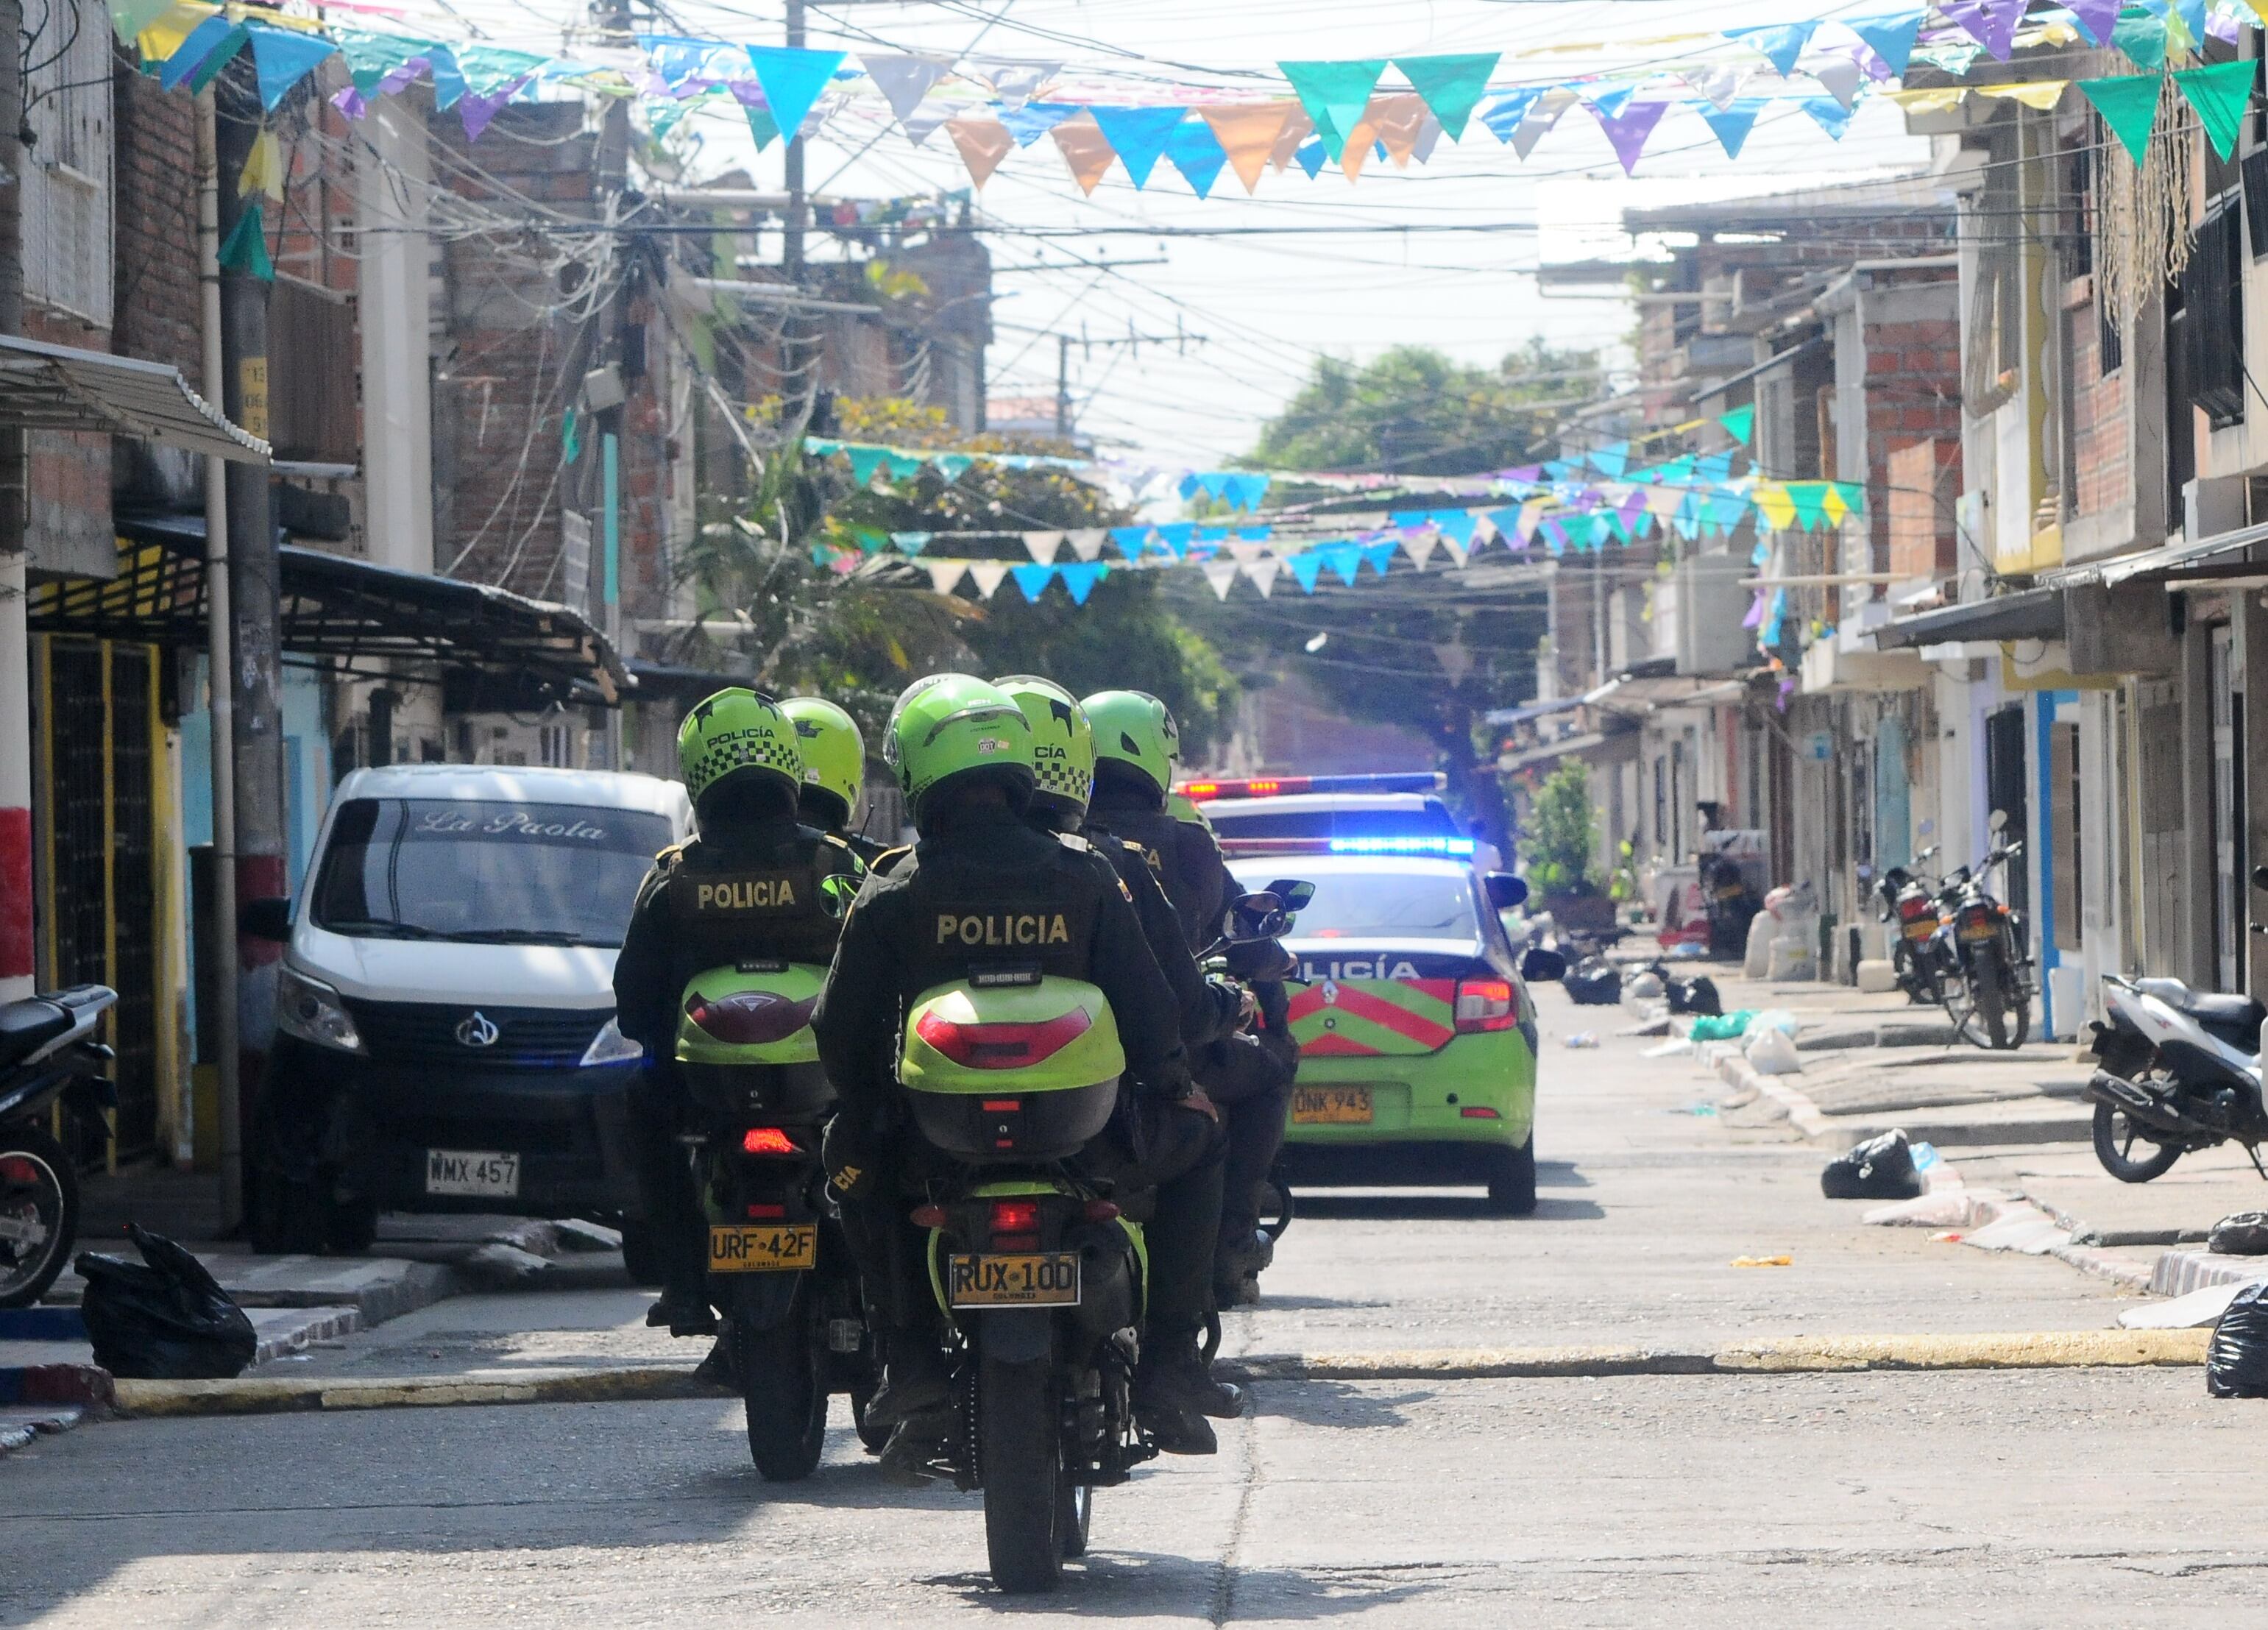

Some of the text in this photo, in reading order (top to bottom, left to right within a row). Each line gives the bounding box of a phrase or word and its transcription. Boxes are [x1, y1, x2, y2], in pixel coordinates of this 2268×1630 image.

[706, 726, 775, 748] POLICÍA
[1034, 743, 1067, 760] CÍA
[415, 812, 607, 840] La Paola
[698, 879, 795, 909] POLICIA
[937, 914, 1069, 945] POLICIA
[1296, 953, 1421, 979] LICÍA
[430, 1157, 515, 1184] WMX 457
[832, 1166, 862, 1191] CIA
[712, 1232, 812, 1259] URF 42F
[957, 1262, 1009, 1292] RUX
